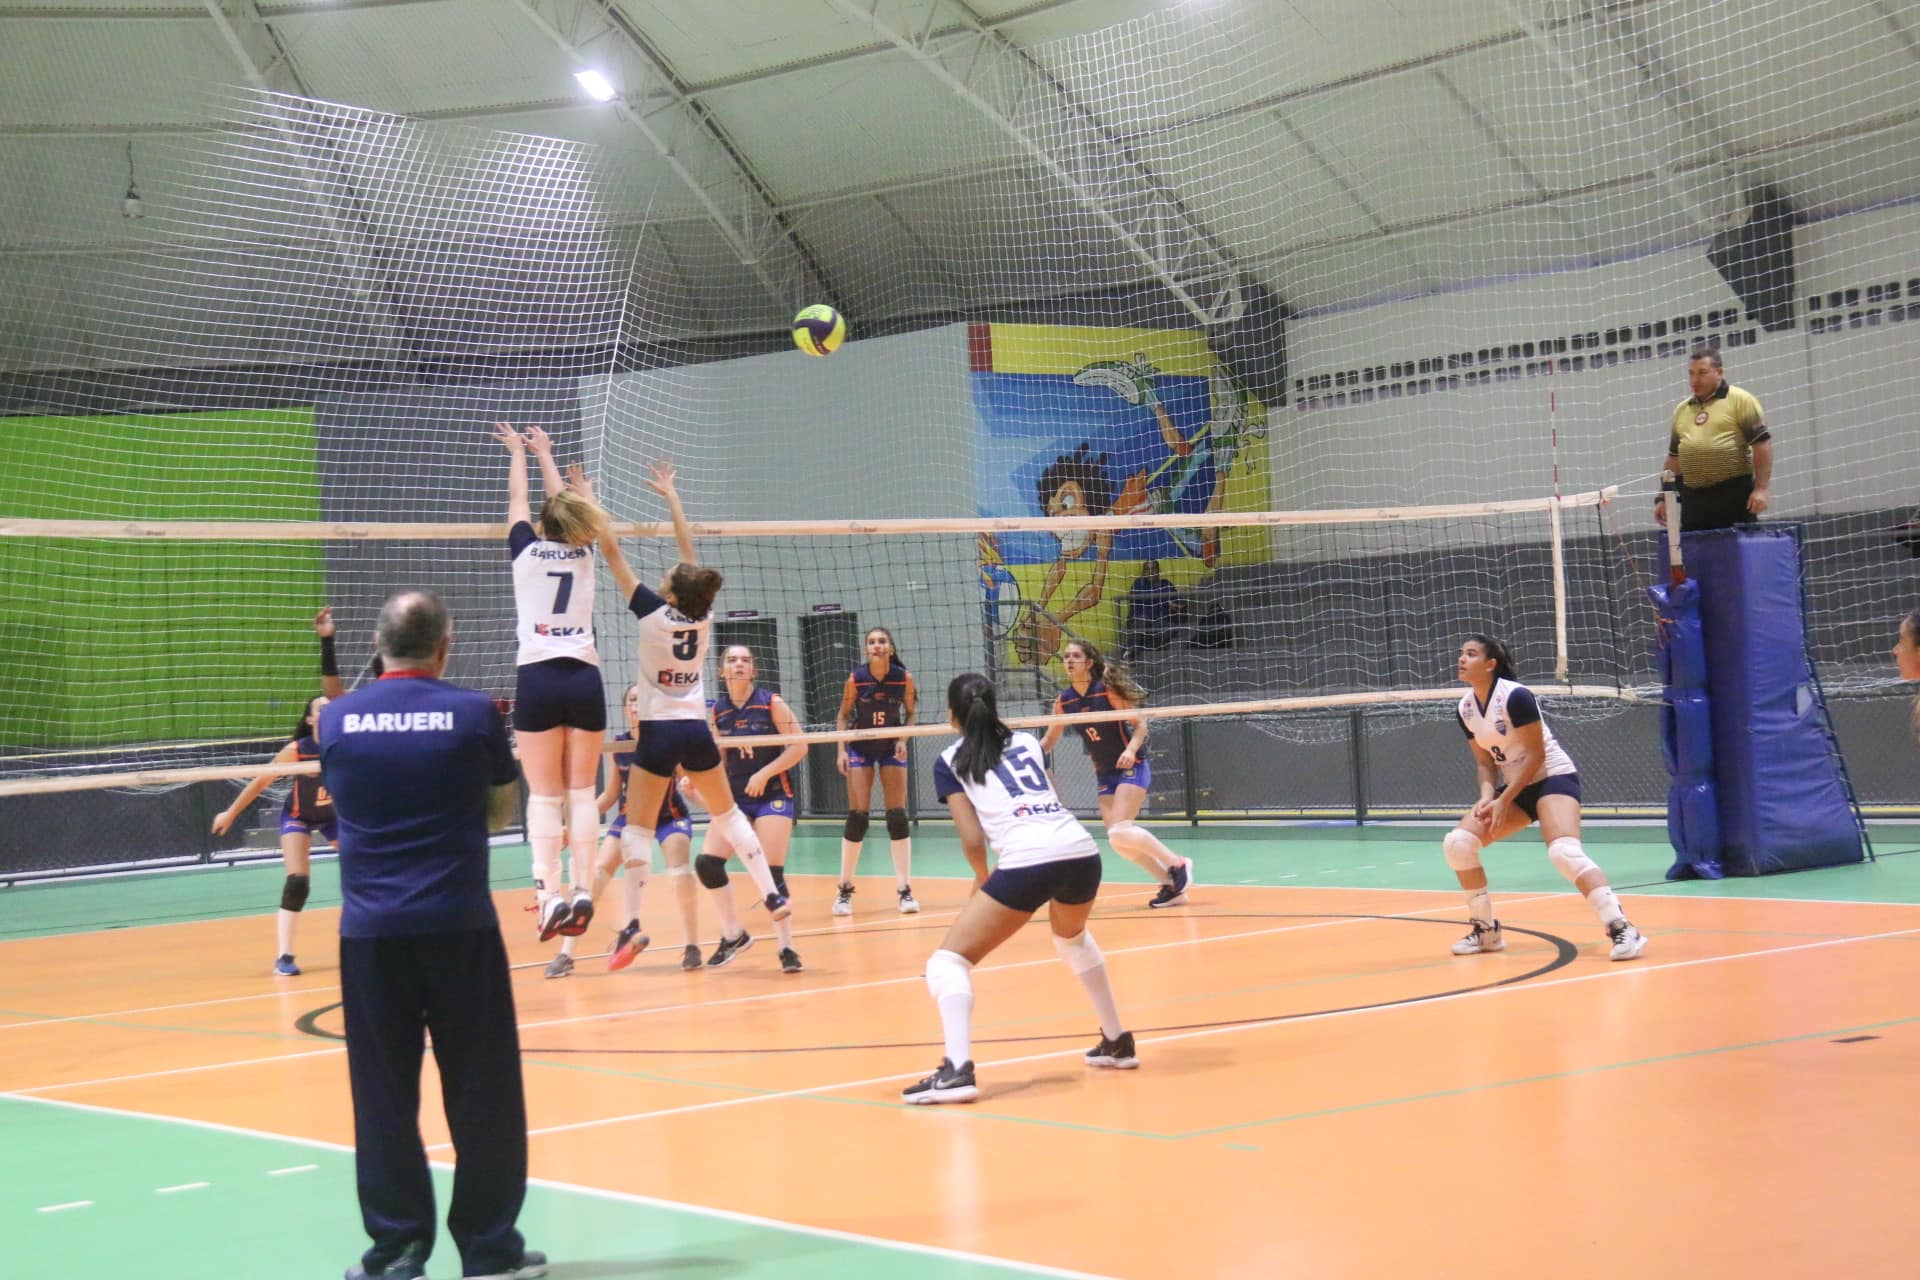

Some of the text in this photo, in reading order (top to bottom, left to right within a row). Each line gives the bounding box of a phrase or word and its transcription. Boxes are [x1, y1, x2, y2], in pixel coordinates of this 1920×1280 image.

[547, 571, 573, 614] 7
[672, 629, 699, 661] 3
[657, 668, 699, 687] DEKA
[343, 711, 453, 734] BARUERI
[872, 711, 886, 726] 15
[1085, 727, 1101, 742] 12
[1491, 746, 1506, 761] 8
[991, 745, 1050, 798] 15
